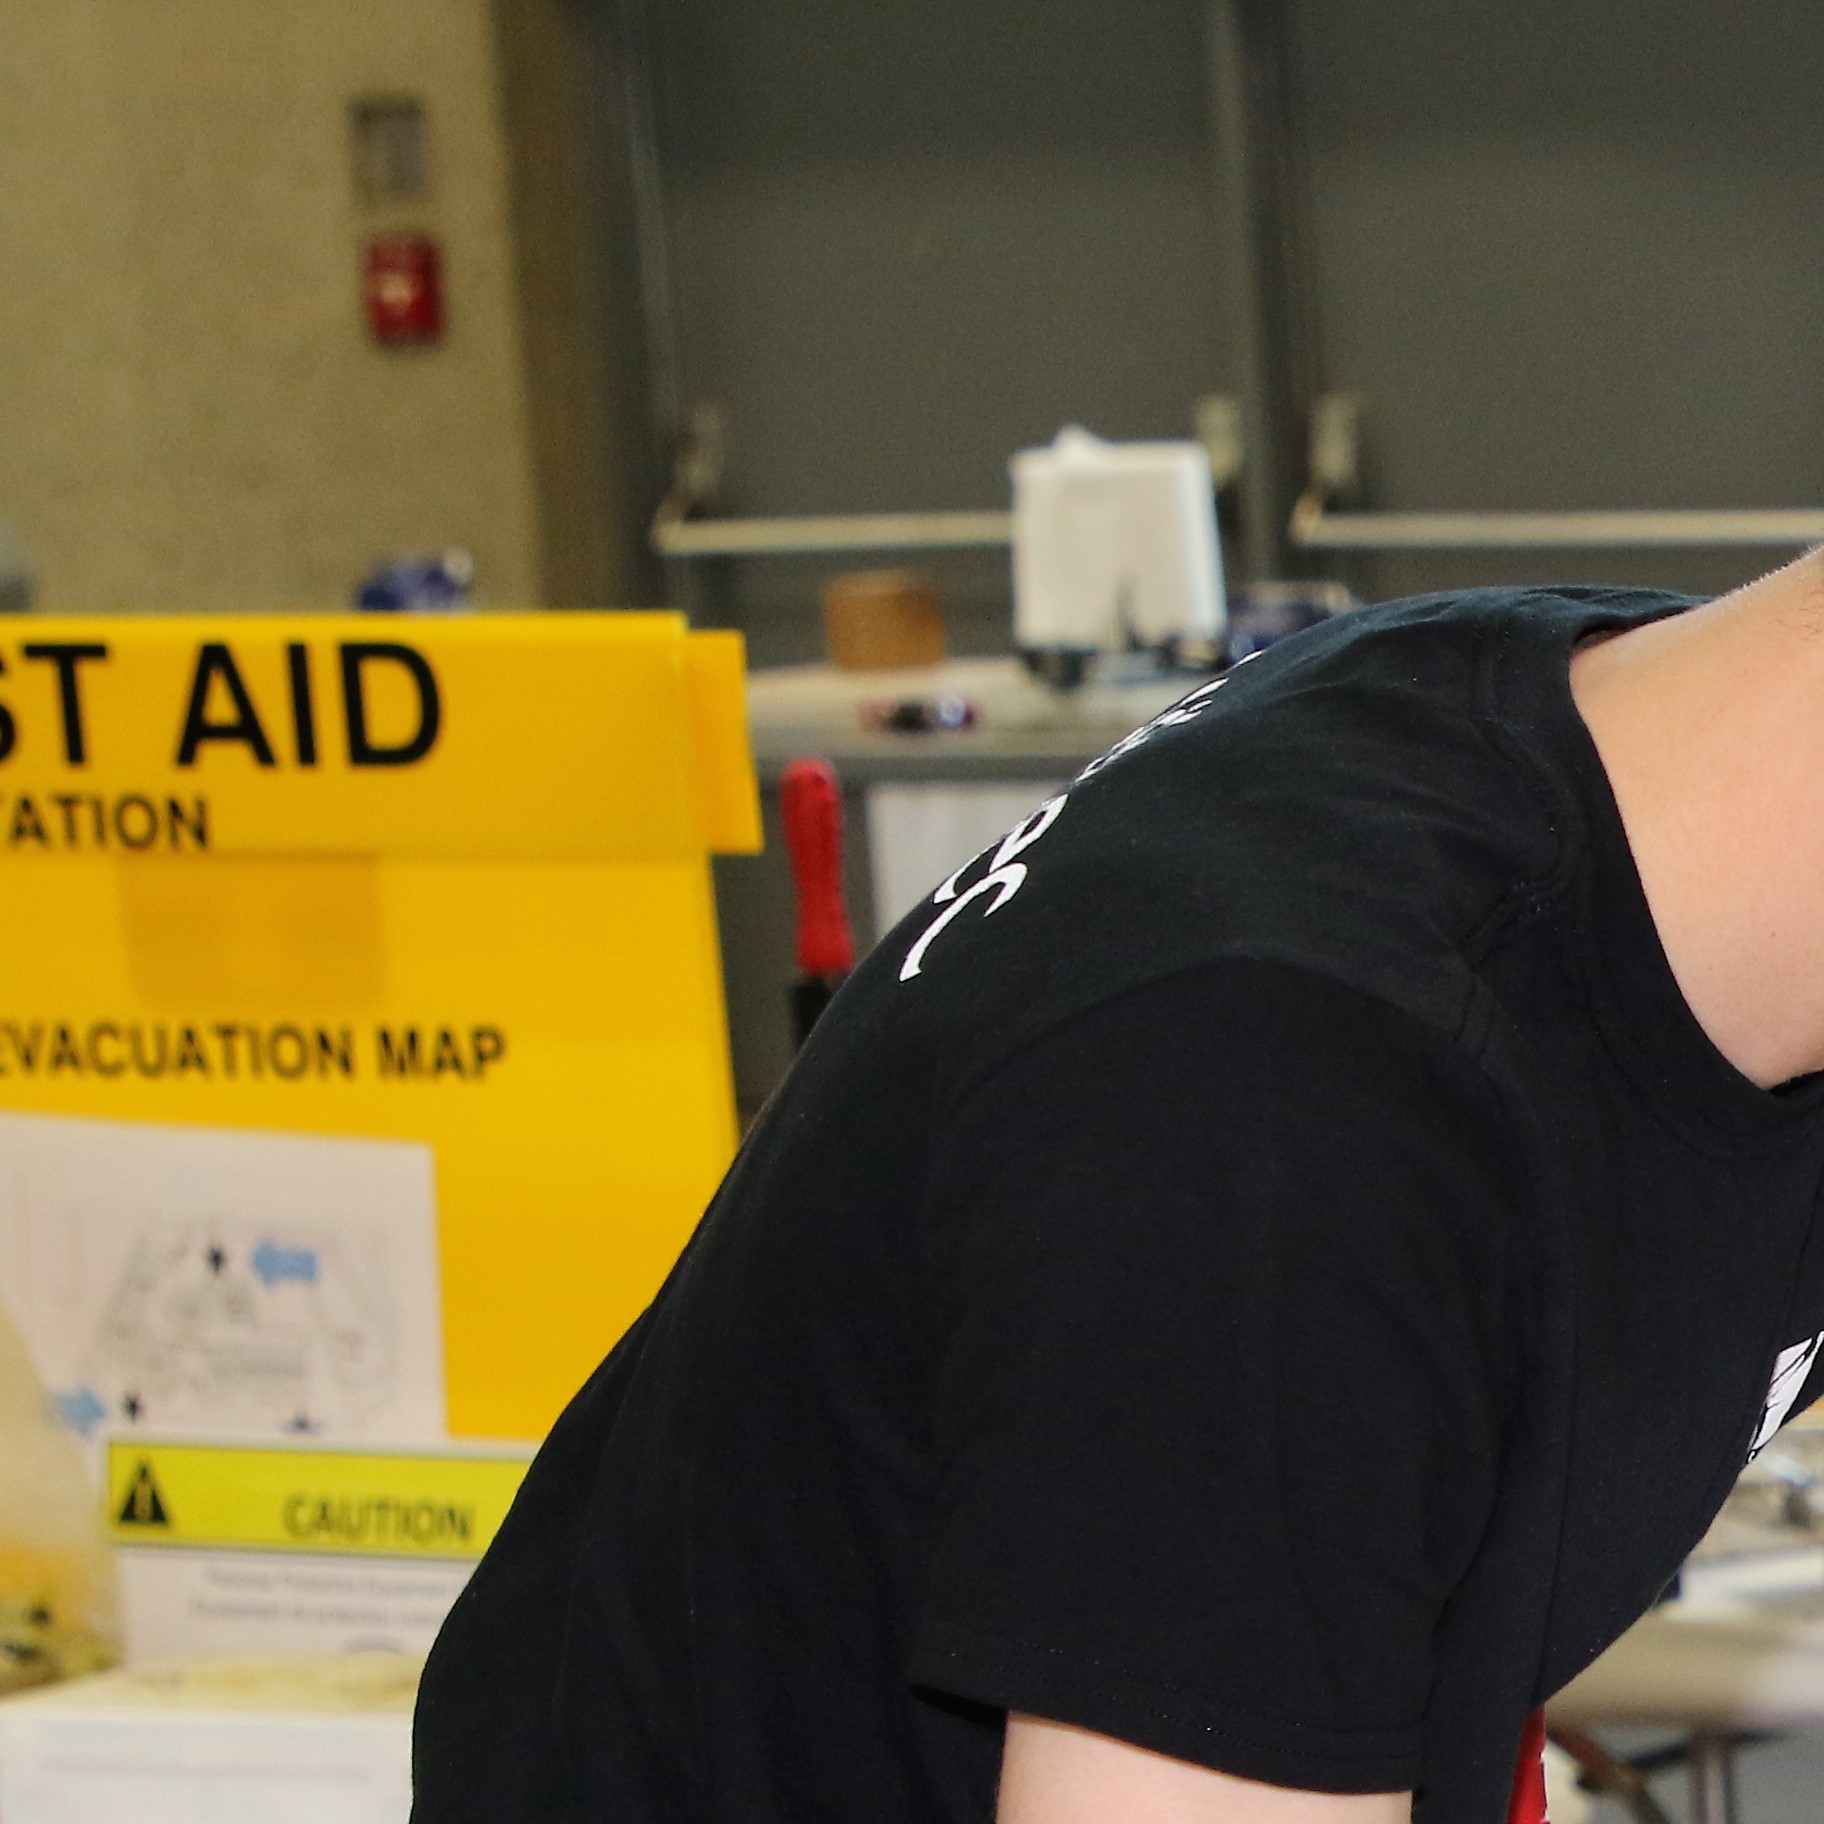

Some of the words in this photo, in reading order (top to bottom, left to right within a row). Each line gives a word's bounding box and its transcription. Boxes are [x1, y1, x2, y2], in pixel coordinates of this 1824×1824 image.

[176, 641, 443, 768] AID
[0, 794, 208, 850] ATION
[0, 1023, 354, 1080] VACUATION
[376, 1025, 507, 1082] MAP
[283, 1492, 476, 1545] CAUTION
